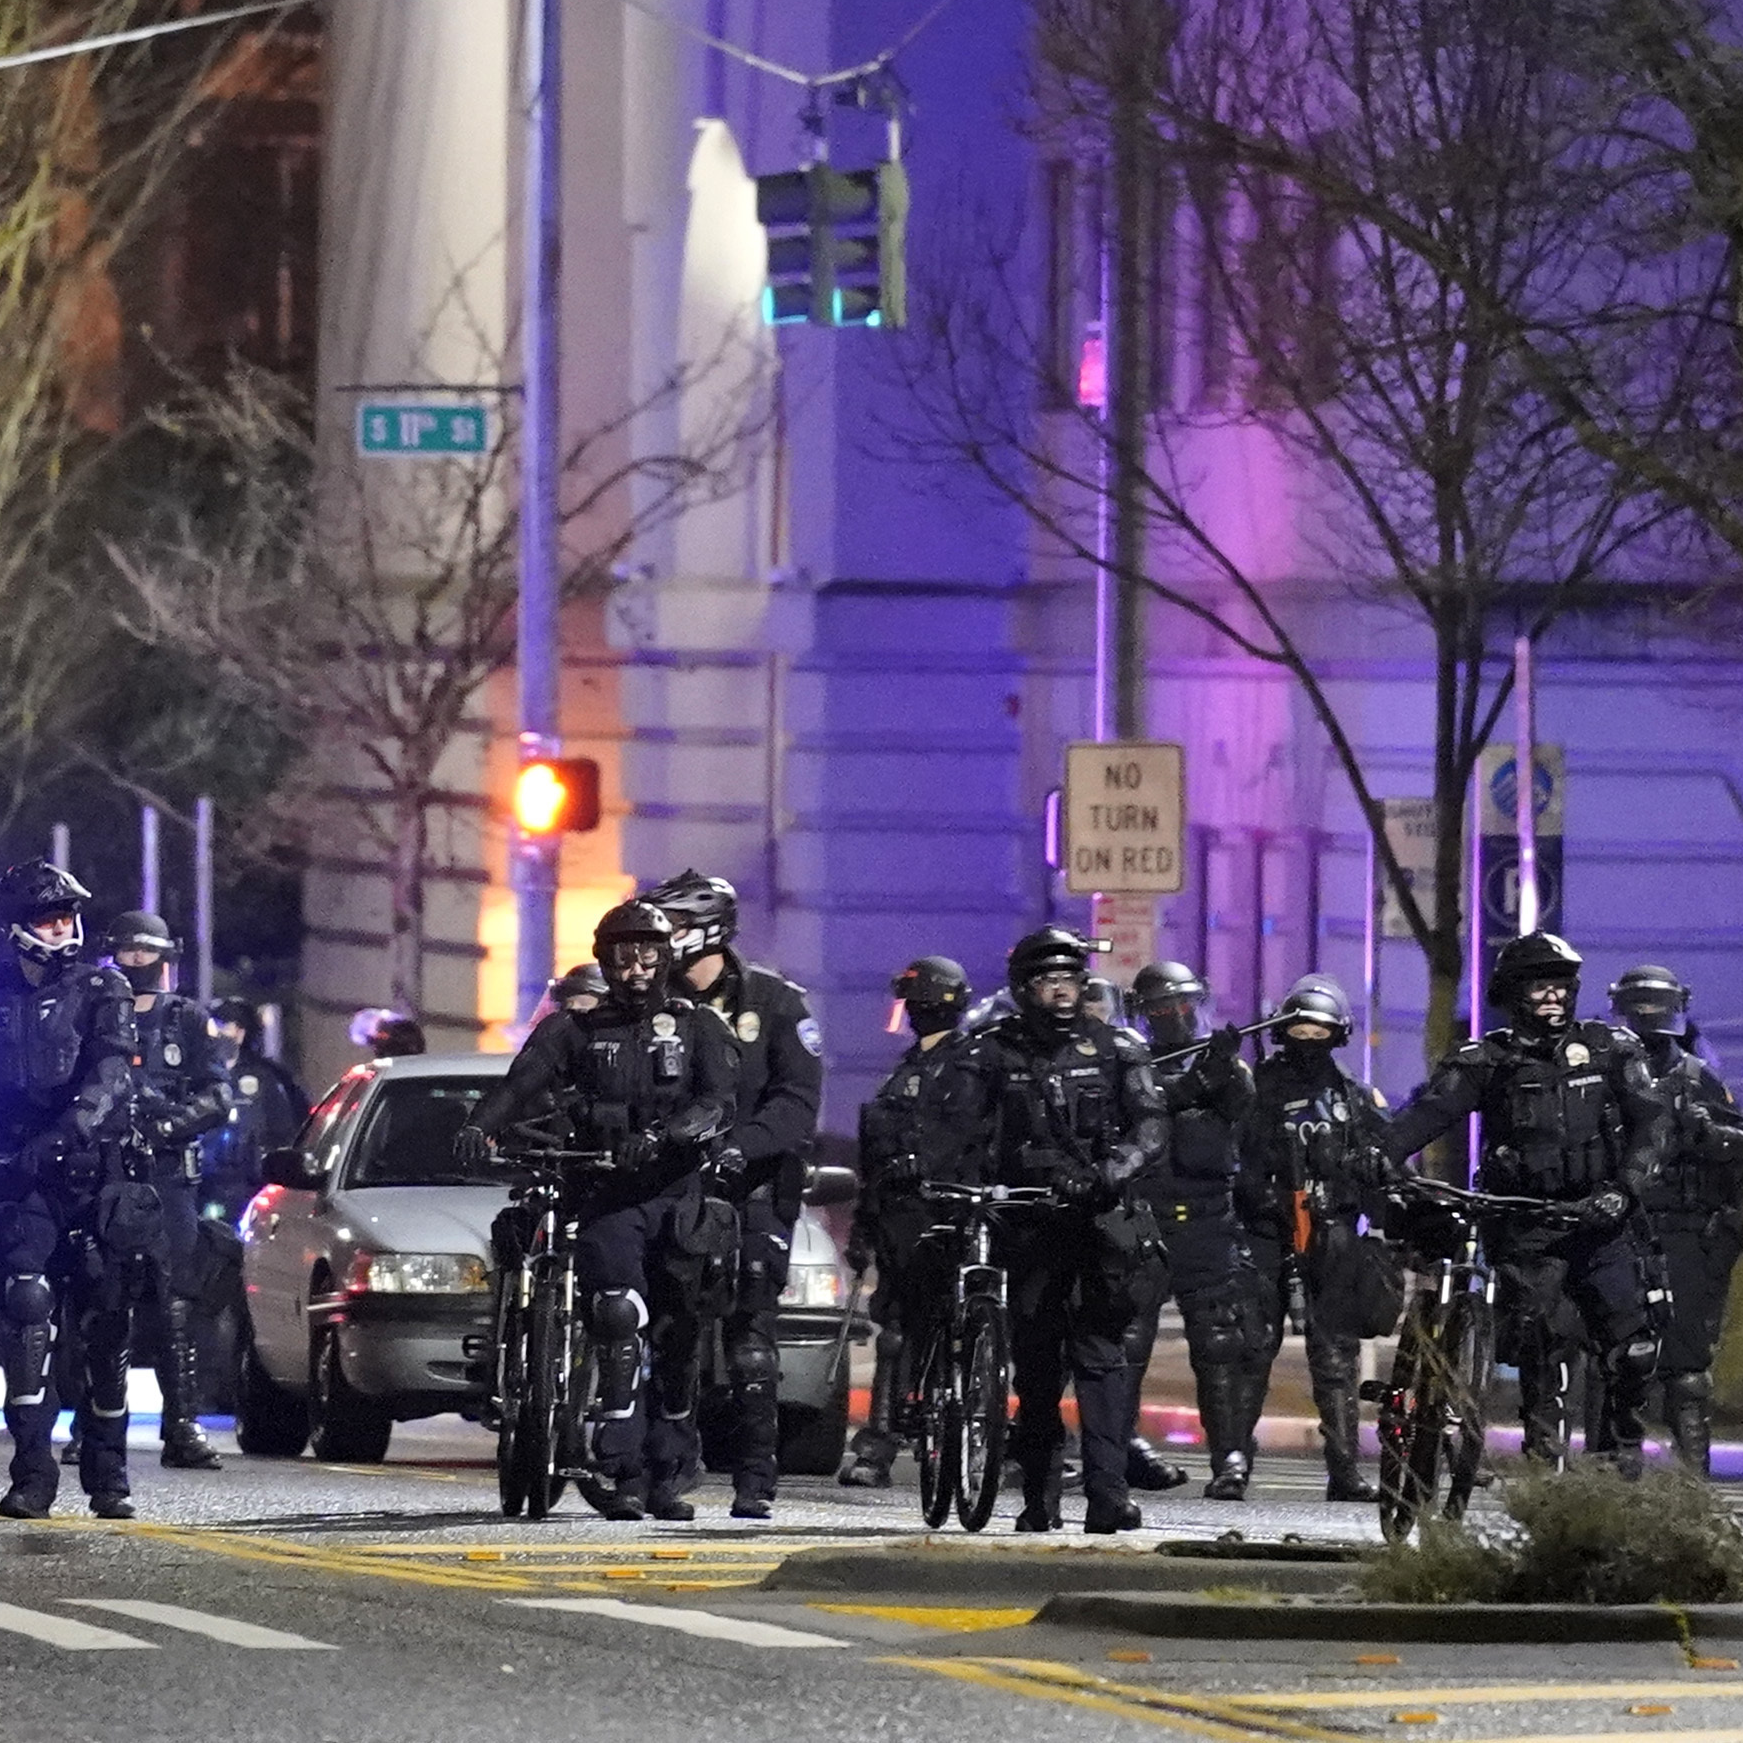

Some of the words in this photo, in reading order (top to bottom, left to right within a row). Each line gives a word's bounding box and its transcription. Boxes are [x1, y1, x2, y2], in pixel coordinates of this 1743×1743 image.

[1105, 761, 1143, 790] NO
[1089, 804, 1159, 833] TURN
[1075, 846, 1111, 874] ON
[1122, 846, 1175, 874] RED
